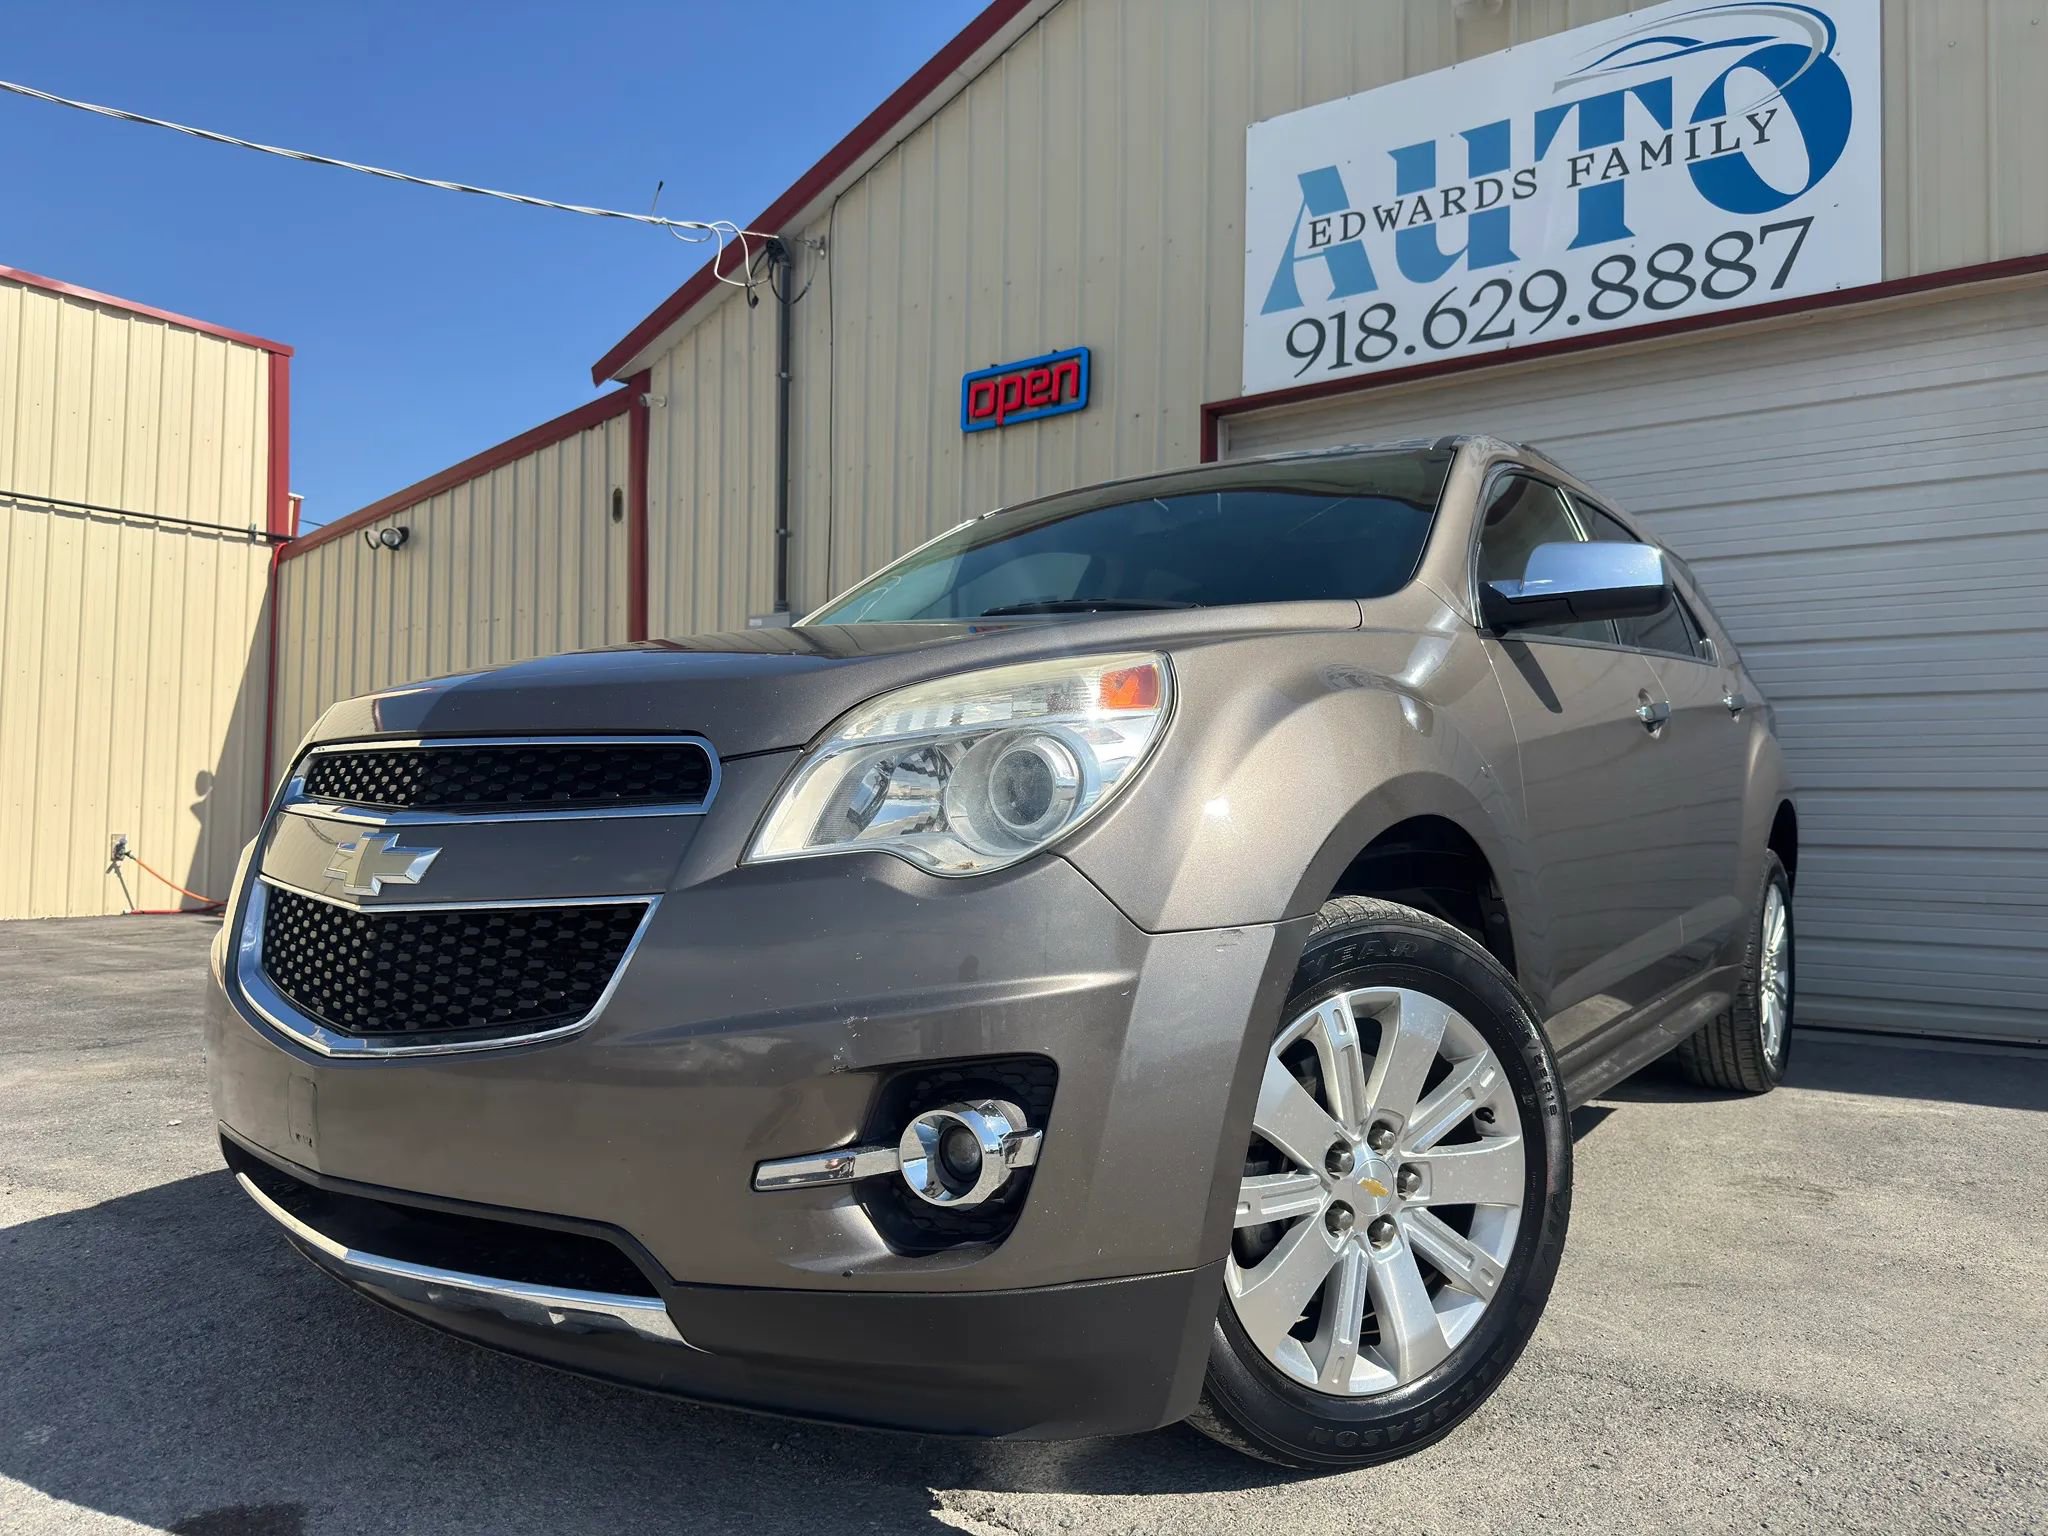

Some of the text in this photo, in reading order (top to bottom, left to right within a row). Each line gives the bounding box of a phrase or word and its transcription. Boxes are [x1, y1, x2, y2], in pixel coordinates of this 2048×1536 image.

[1260, 43, 1853, 316] AUTO
[1307, 108, 1779, 249] EDWARDS FAMILY
[1285, 216, 1815, 379] 918.629.8887
[968, 361, 1080, 426] open
